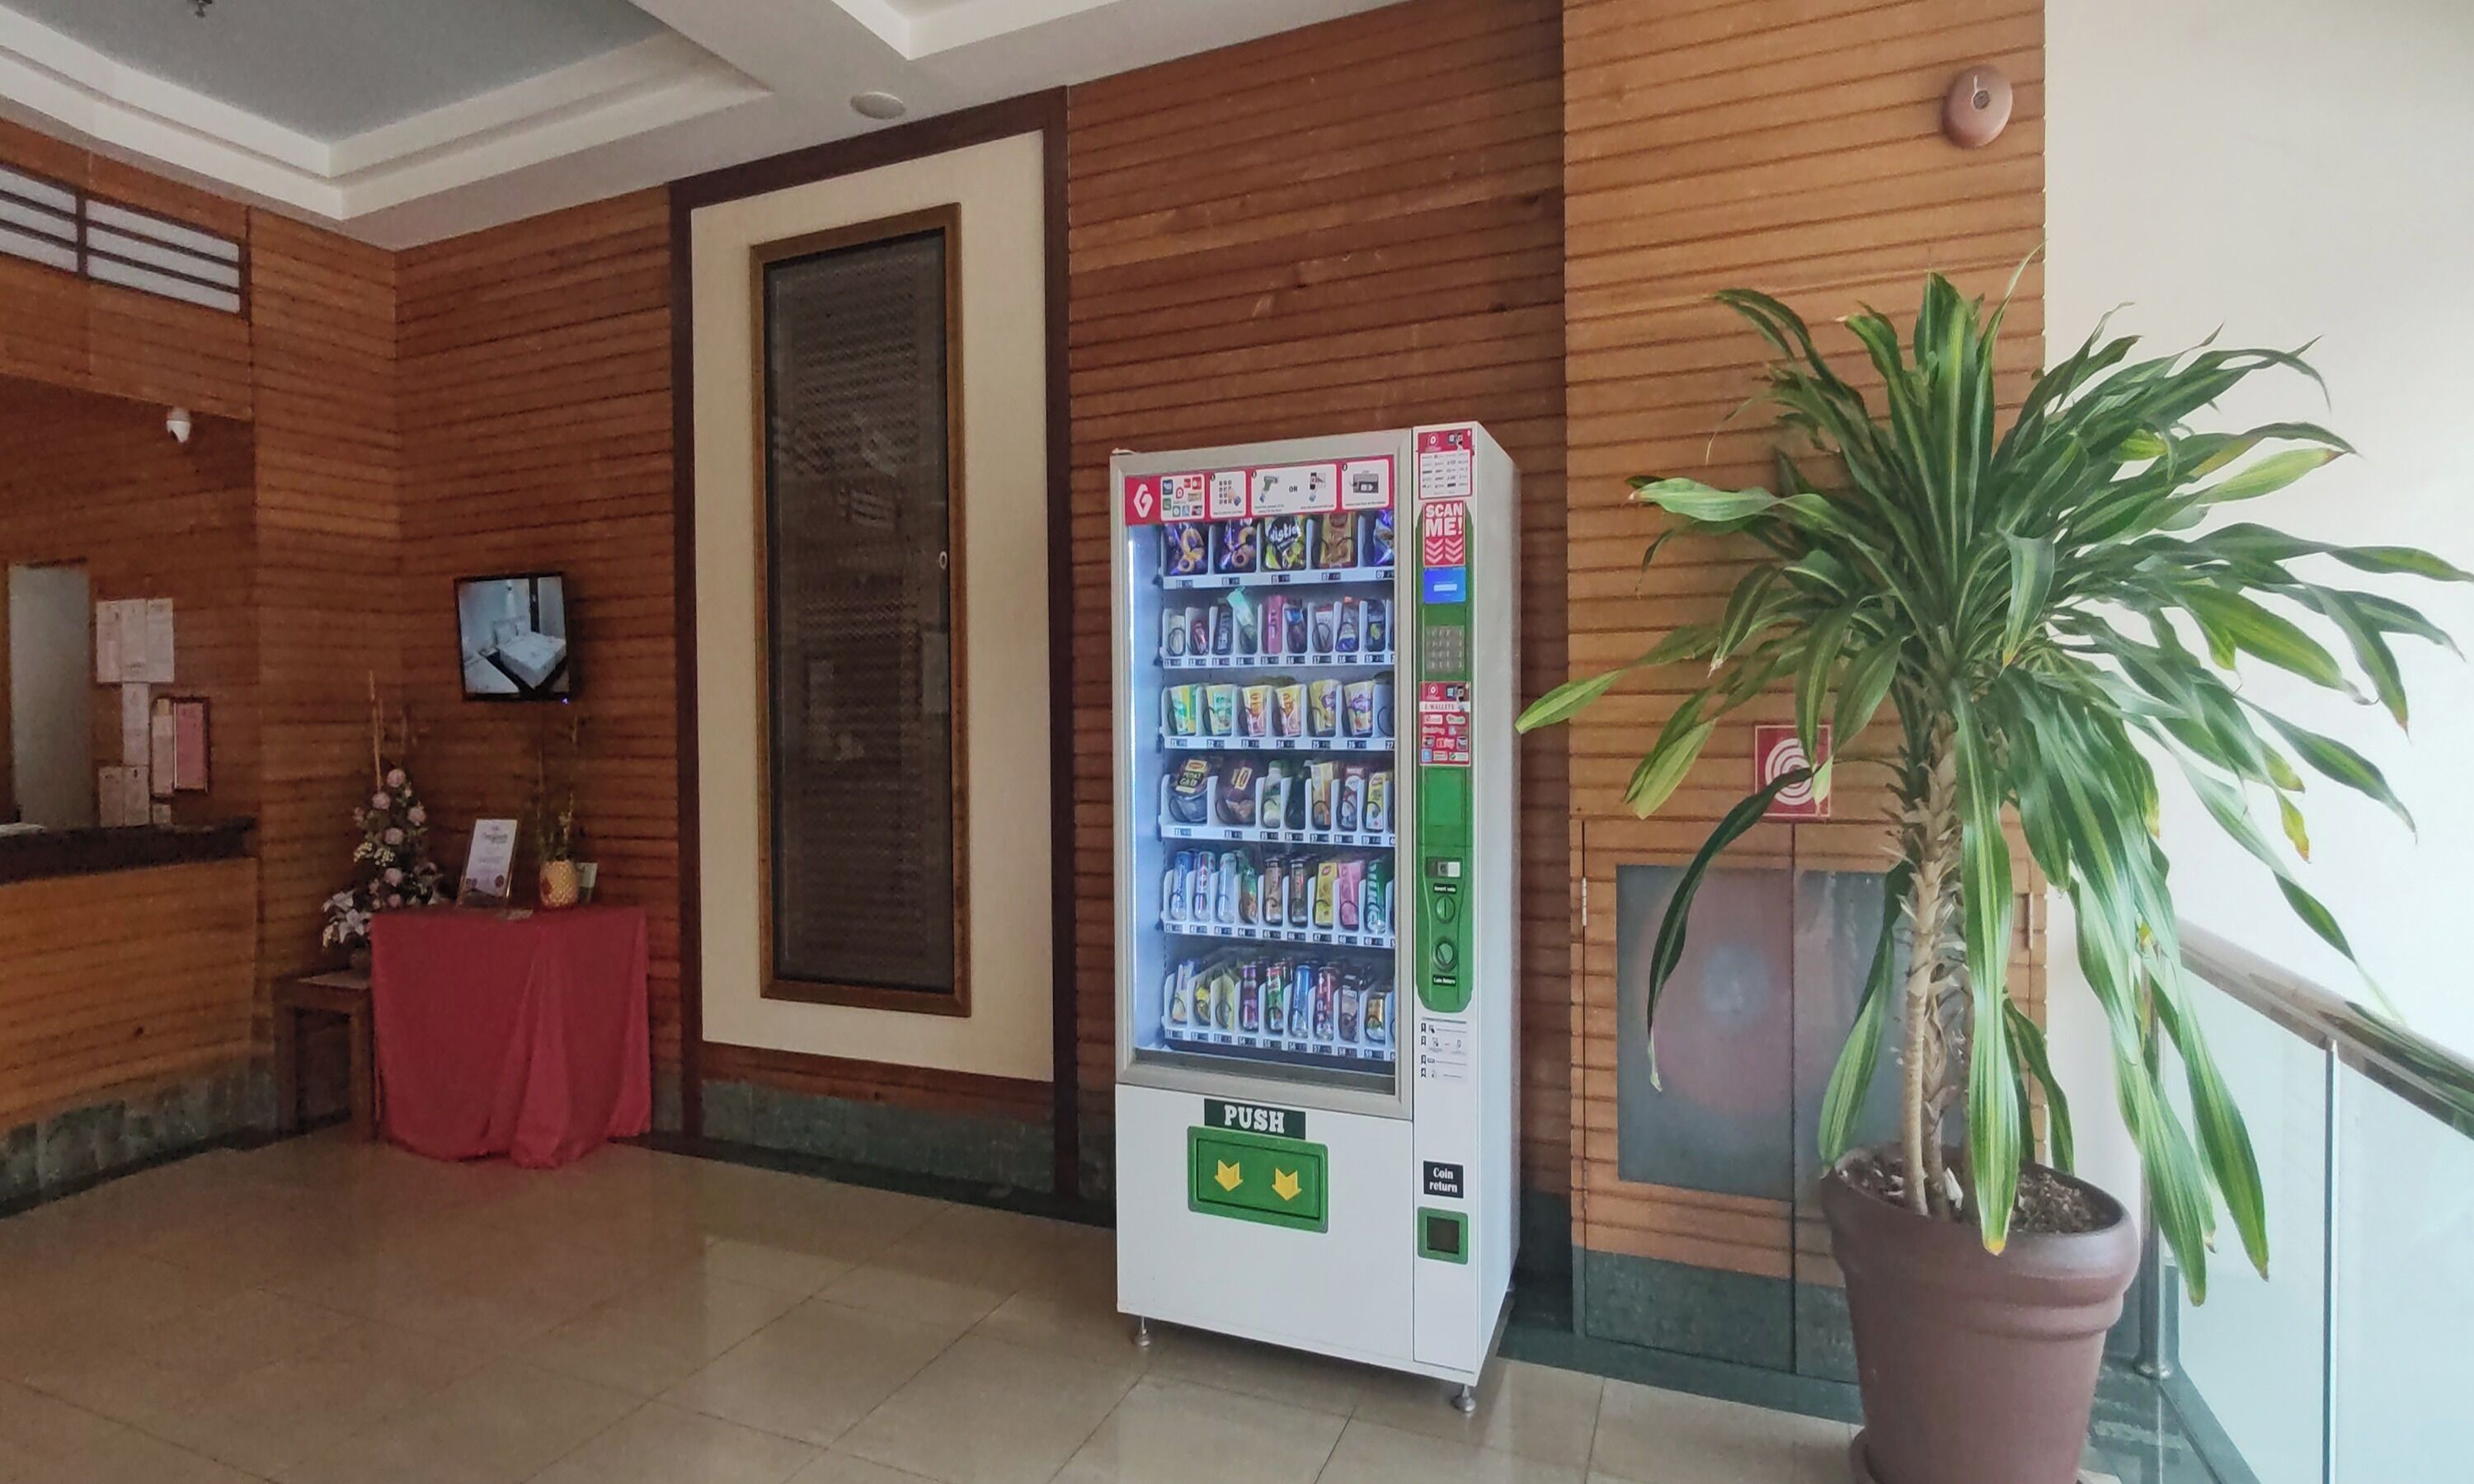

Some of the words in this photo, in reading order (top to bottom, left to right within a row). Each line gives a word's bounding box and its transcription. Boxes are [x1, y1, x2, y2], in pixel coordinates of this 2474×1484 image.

[1288, 485, 1298, 493] OR
[1425, 502, 1463, 519] SCAN
[1425, 517, 1463, 538] ME!
[1224, 1104, 1285, 1134] PUSH
[1432, 1167, 1453, 1180] Coin
[1429, 1181, 1458, 1194] return
